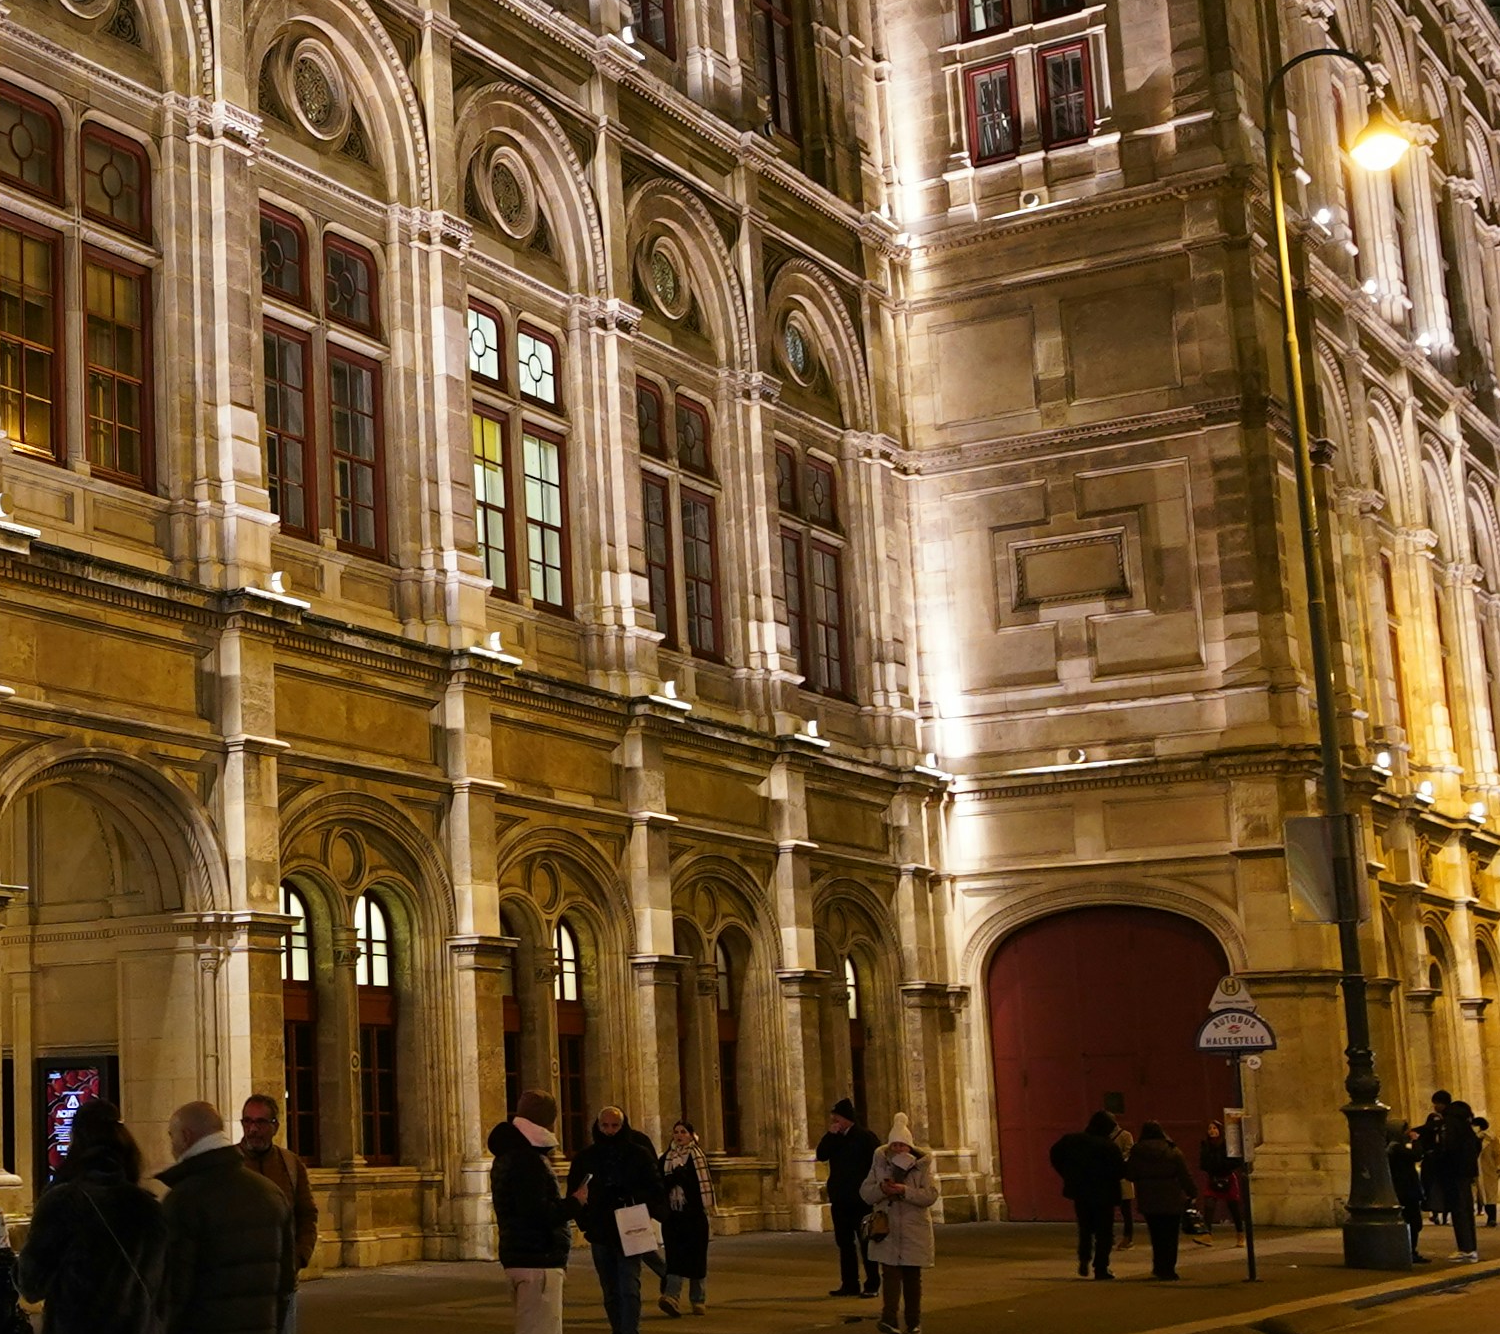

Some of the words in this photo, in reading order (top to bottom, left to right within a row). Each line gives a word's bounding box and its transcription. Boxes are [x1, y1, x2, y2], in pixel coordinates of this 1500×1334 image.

[1225, 979, 1237, 993] H
[1213, 1015, 1256, 1029] AUTOBUS
[1206, 1036, 1265, 1045] HALTESTELLE
